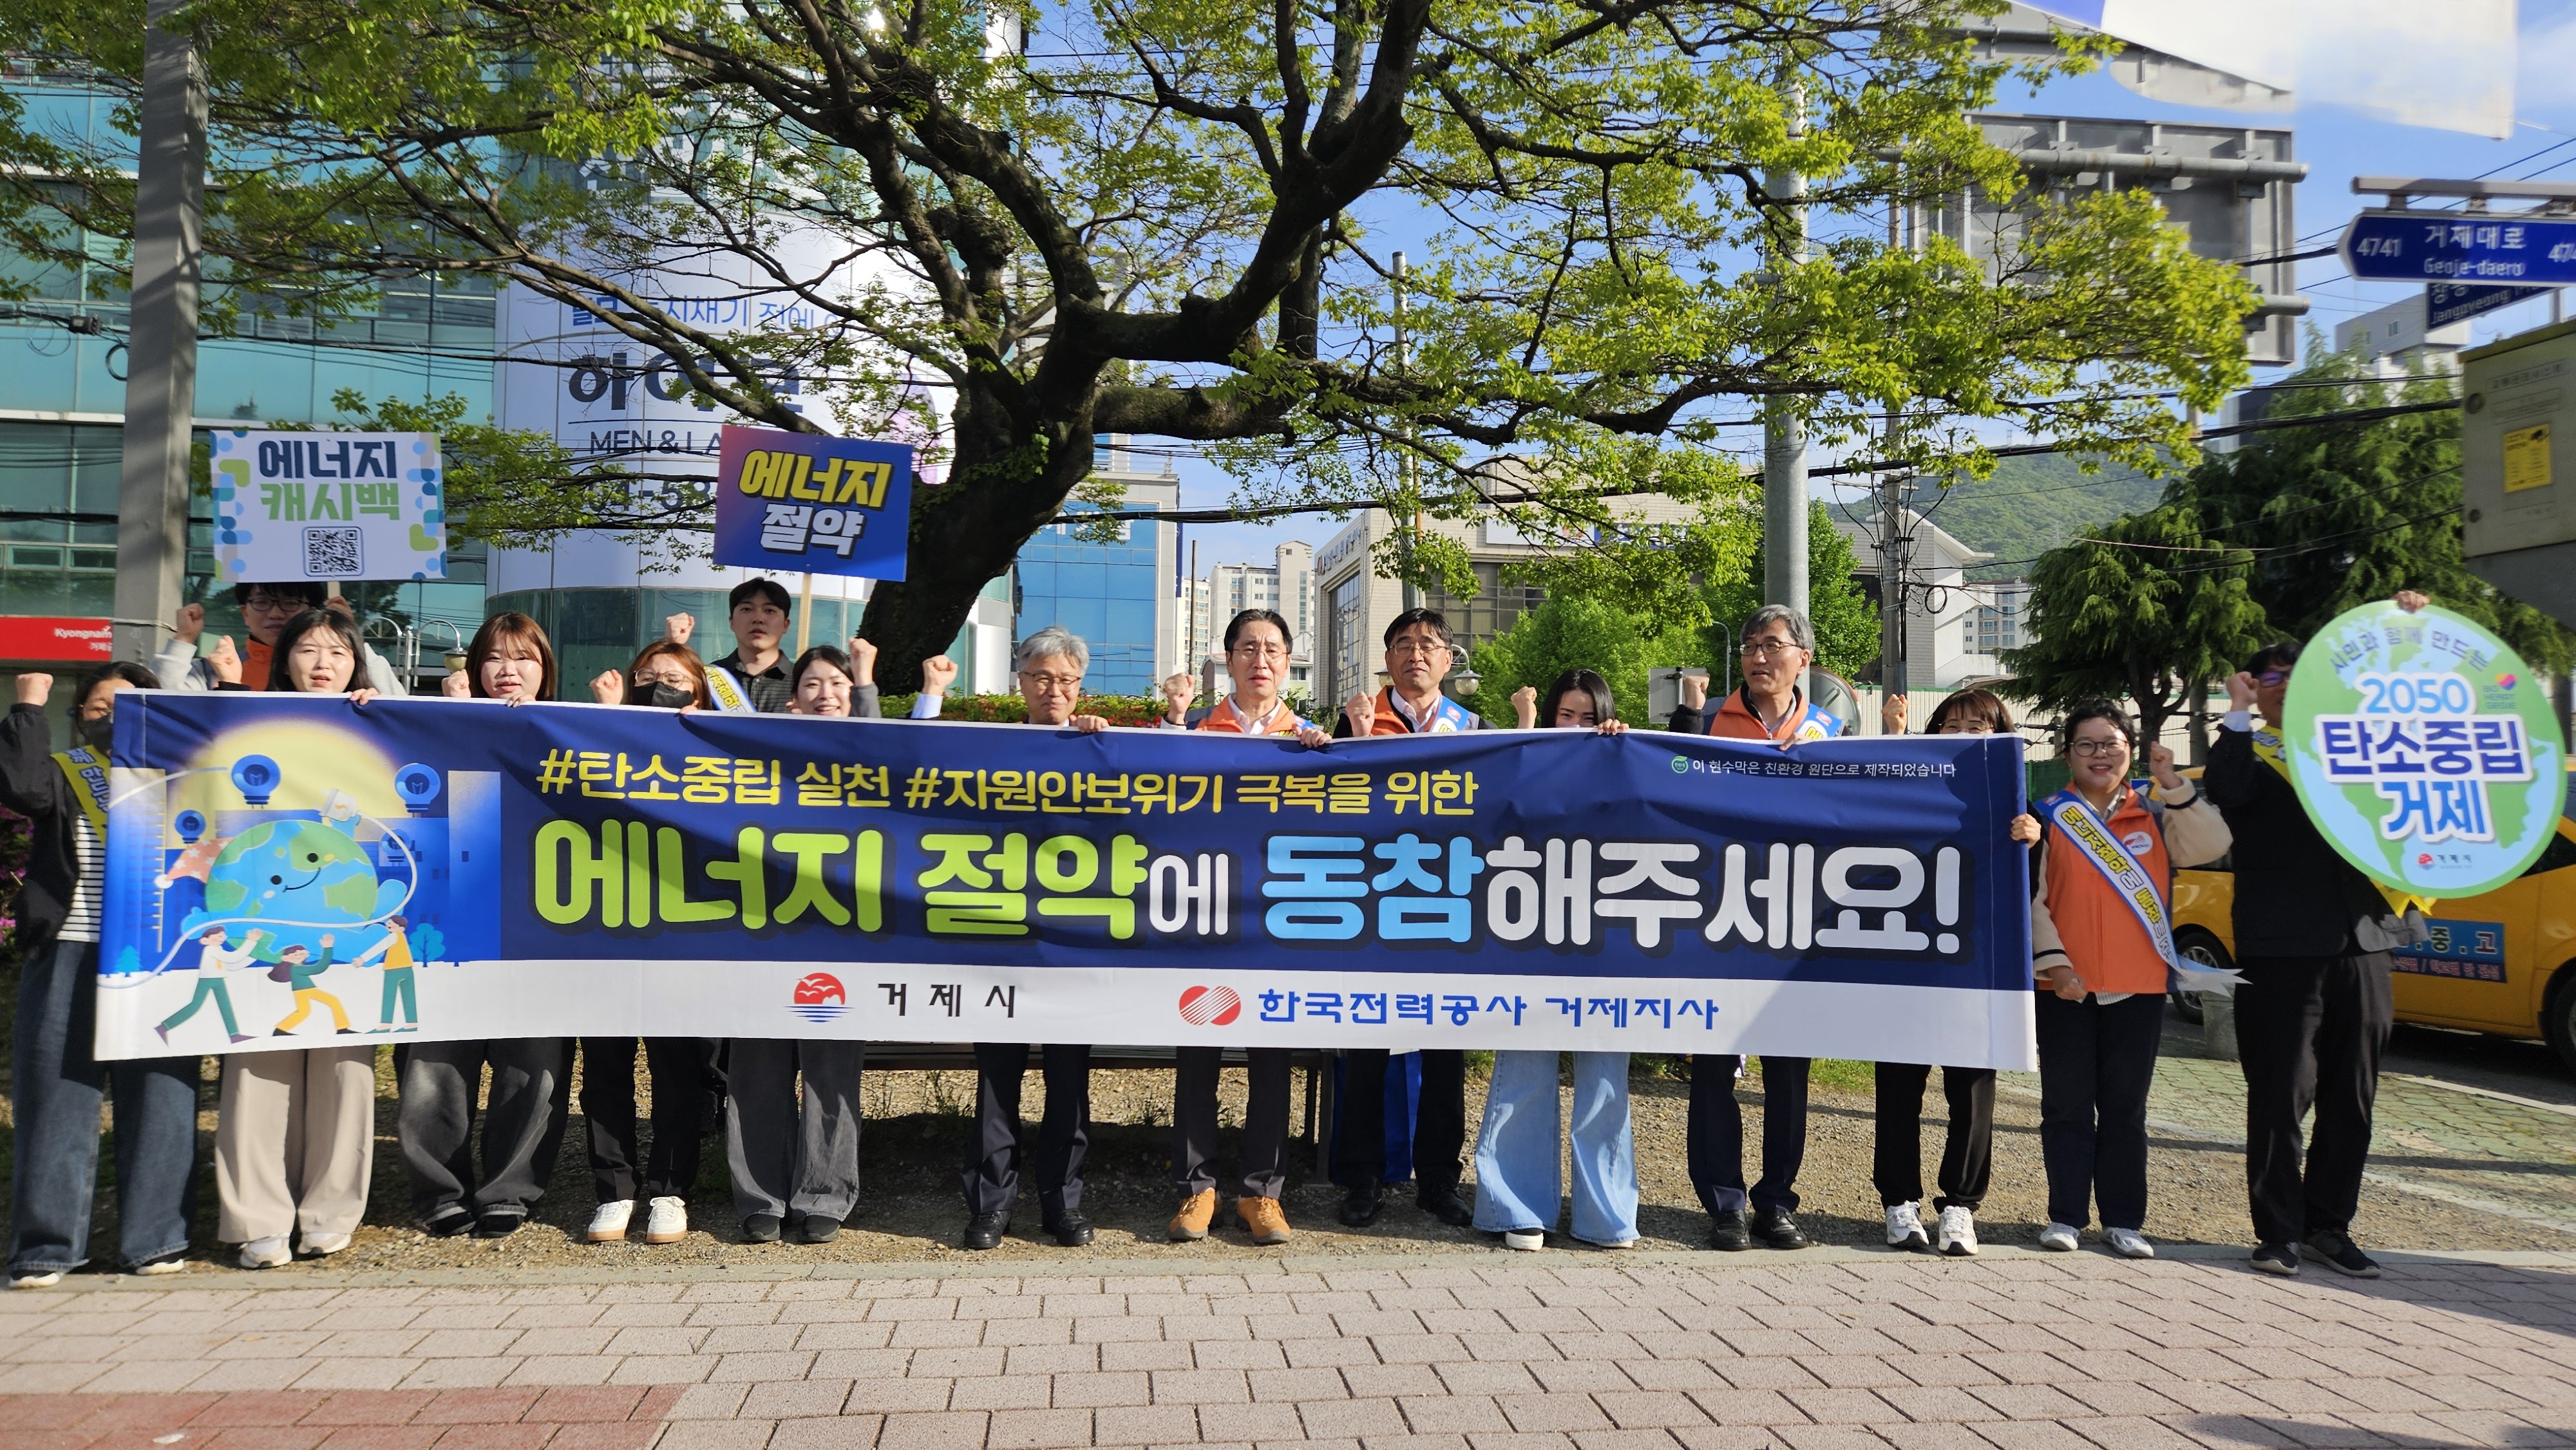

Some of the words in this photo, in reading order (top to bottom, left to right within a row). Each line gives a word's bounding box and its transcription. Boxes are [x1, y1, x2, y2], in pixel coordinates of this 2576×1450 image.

[2356, 238, 2402, 258] 4741
[2425, 225, 2526, 249] 거제대로
[2424, 258, 2526, 277] Geoje-daero
[258, 440, 398, 479] 에너지
[590, 429, 652, 455] MEN
[658, 429, 680, 455] &
[739, 449, 893, 509] 에너지
[260, 482, 401, 522] 캐시백
[759, 503, 866, 557] 절약
[2329, 630, 2380, 673] 시민과
[2384, 626, 2423, 646] 함께
[2430, 630, 2490, 673] 만드는
[2361, 677, 2469, 715] 2050
[2321, 720, 2526, 775] 탄소중립
[536, 748, 781, 805] #탄소중립
[795, 762, 891, 807] 실천
[903, 766, 1223, 815] #자원안보위기
[1236, 773, 1373, 814] 극복을
[1384, 769, 1479, 816] 위한
[1692, 760, 1705, 773] 이
[1709, 760, 1761, 775] 현수막은
[1765, 761, 1803, 775] 친환경
[1808, 763, 1861, 776] 원단으로
[1864, 763, 1956, 778] 제작되었습니다
[2382, 779, 2487, 836] 거제
[535, 818, 884, 933] 에너지
[917, 831, 1229, 940] 절약에
[1262, 833, 1961, 954] 동참해주세요!
[2398, 925, 2498, 956] .중.고
[1258, 988, 1528, 1026] 한국전력공사
[1545, 996, 1719, 1030] 거제지사
